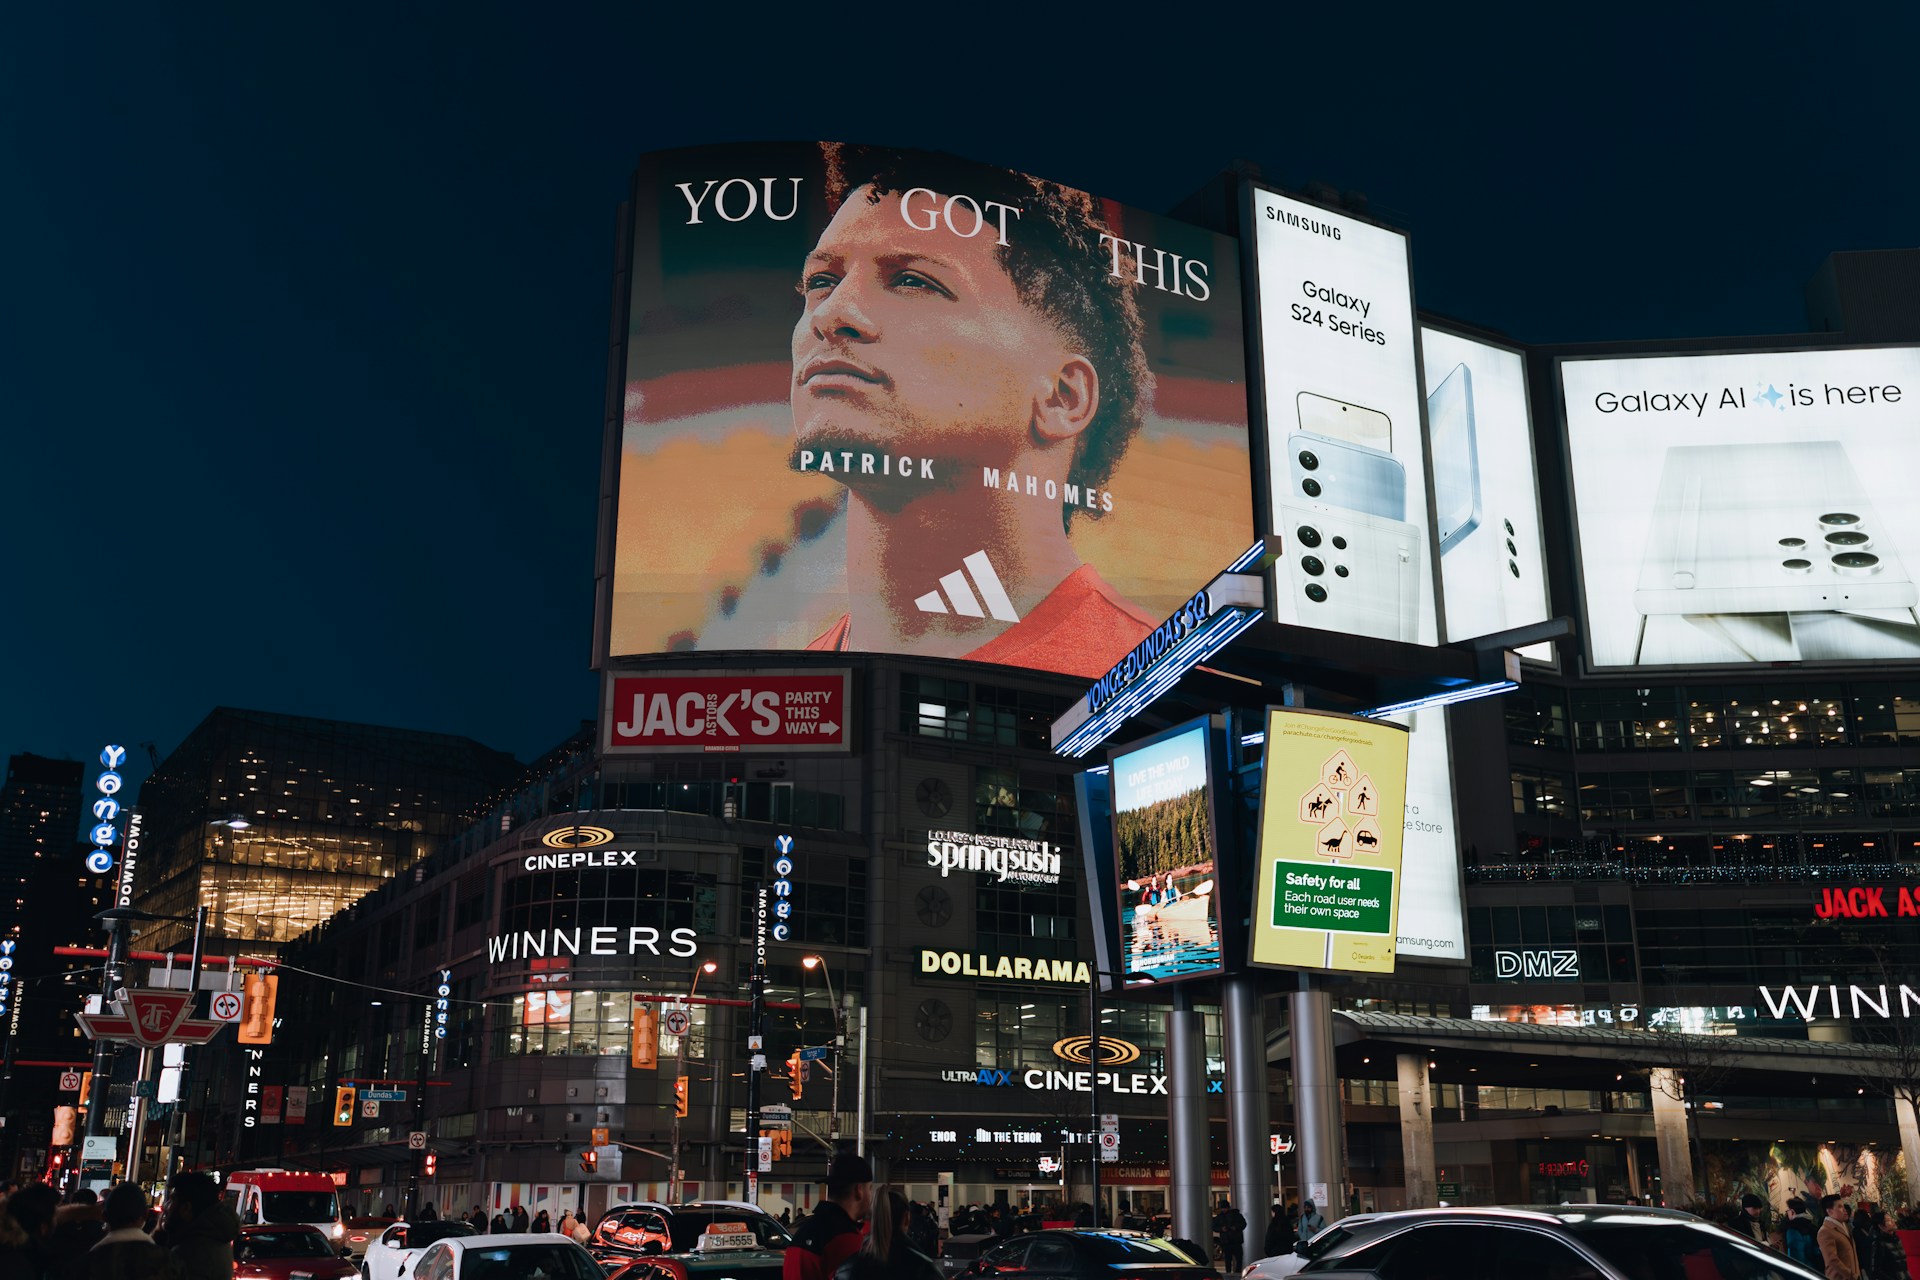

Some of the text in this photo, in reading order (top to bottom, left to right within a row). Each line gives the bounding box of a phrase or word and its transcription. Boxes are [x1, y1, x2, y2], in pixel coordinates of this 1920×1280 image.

[1266, 205, 1341, 241] SAMSUNG
[675, 177, 1211, 302] YOU GOT THIS
[1302, 280, 1371, 319] Galaxy
[1291, 303, 1386, 346] S24 Series
[1595, 383, 1902, 418] Galaxy AI is here
[800, 449, 1115, 512] PATRICK MAHOMES
[1185, 590, 1212, 630] SQ
[785, 691, 833, 704] PARTY
[786, 706, 820, 720] THIS
[706, 693, 718, 737] ASTORS
[785, 721, 818, 735] WAY
[1128, 755, 1190, 787] LIVE THE WILD
[88, 744, 126, 874] Yonge
[1415, 820, 1443, 834] Store
[119, 814, 143, 906] DOWNTOWN
[524, 850, 637, 871] CINEPLEX
[773, 835, 793, 942] Yonge
[1285, 872, 1360, 890] Safety for all
[1283, 902, 1360, 920] their own space
[1284, 890, 1380, 908] Each road user needs
[1815, 887, 1888, 918] JACK
[757, 889, 767, 965] DOWNTOWN
[488, 926, 698, 964] WINNERS
[921, 950, 1091, 983] DOLLARAMA
[1495, 950, 1579, 978] DMZ
[435, 970, 451, 1038] Yonge
[423, 1004, 432, 1054] DOWNTOWN
[942, 1069, 1012, 1086] ULTRA AVX
[1024, 1070, 1168, 1095] CINEPLEX
[368, 1091, 393, 1099] Dundas
[930, 1131, 956, 1142] ENOR
[993, 1131, 1042, 1144] THE TENOR
[1076, 1133, 1092, 1144] THE
[1118, 1167, 1152, 1178] CANADA
[721, 1224, 743, 1233] Beck
